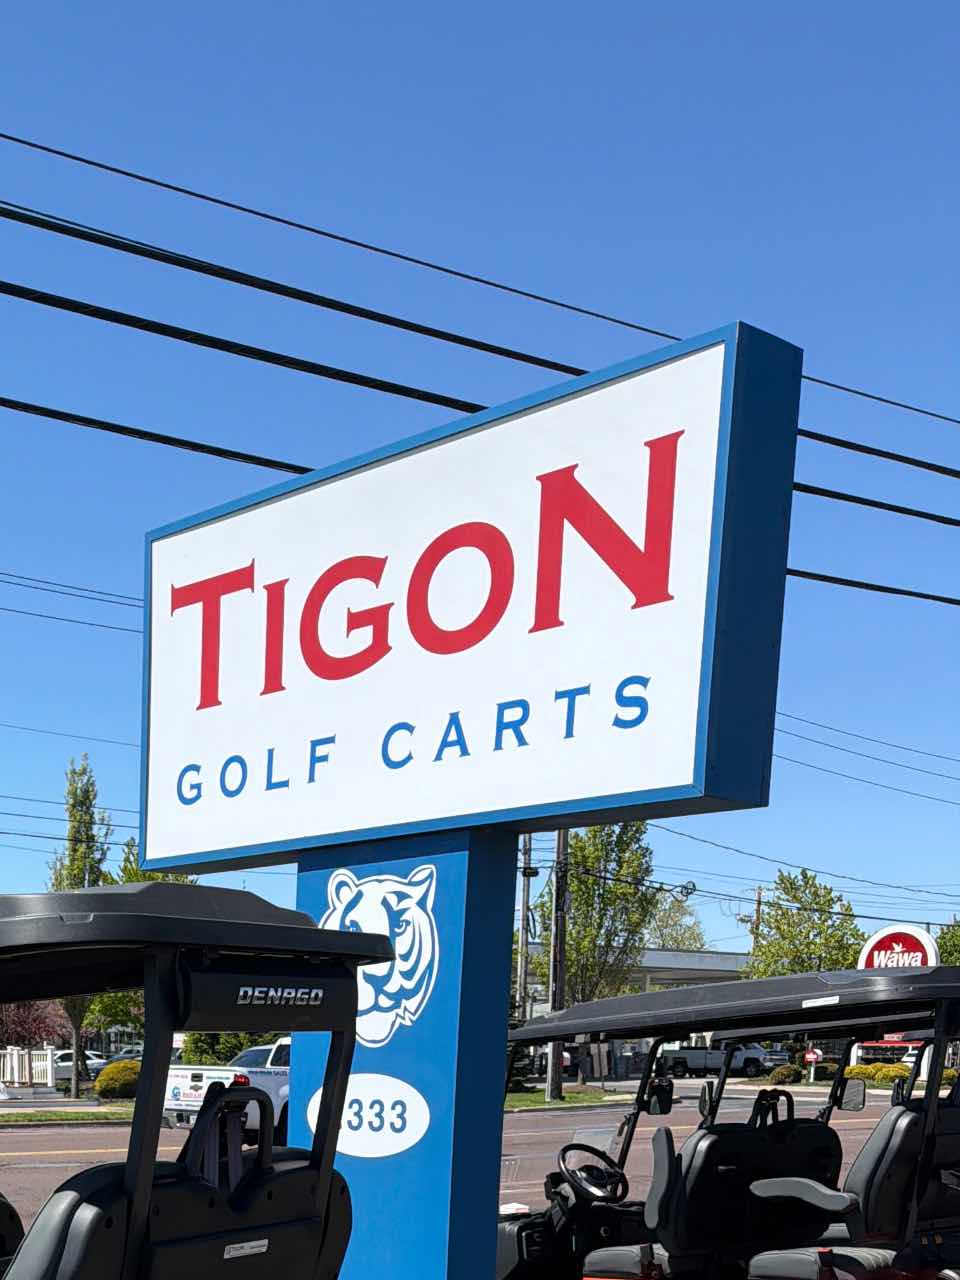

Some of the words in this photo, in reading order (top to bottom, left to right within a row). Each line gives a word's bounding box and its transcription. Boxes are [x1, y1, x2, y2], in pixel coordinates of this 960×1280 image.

[171, 429, 685, 710] TIGON
[176, 734, 336, 806] GOLF
[380, 675, 652, 770] CARTS
[873, 951, 922, 968] Wawa
[236, 986, 324, 1005] DENAGO
[340, 1098, 407, 1134] 333
